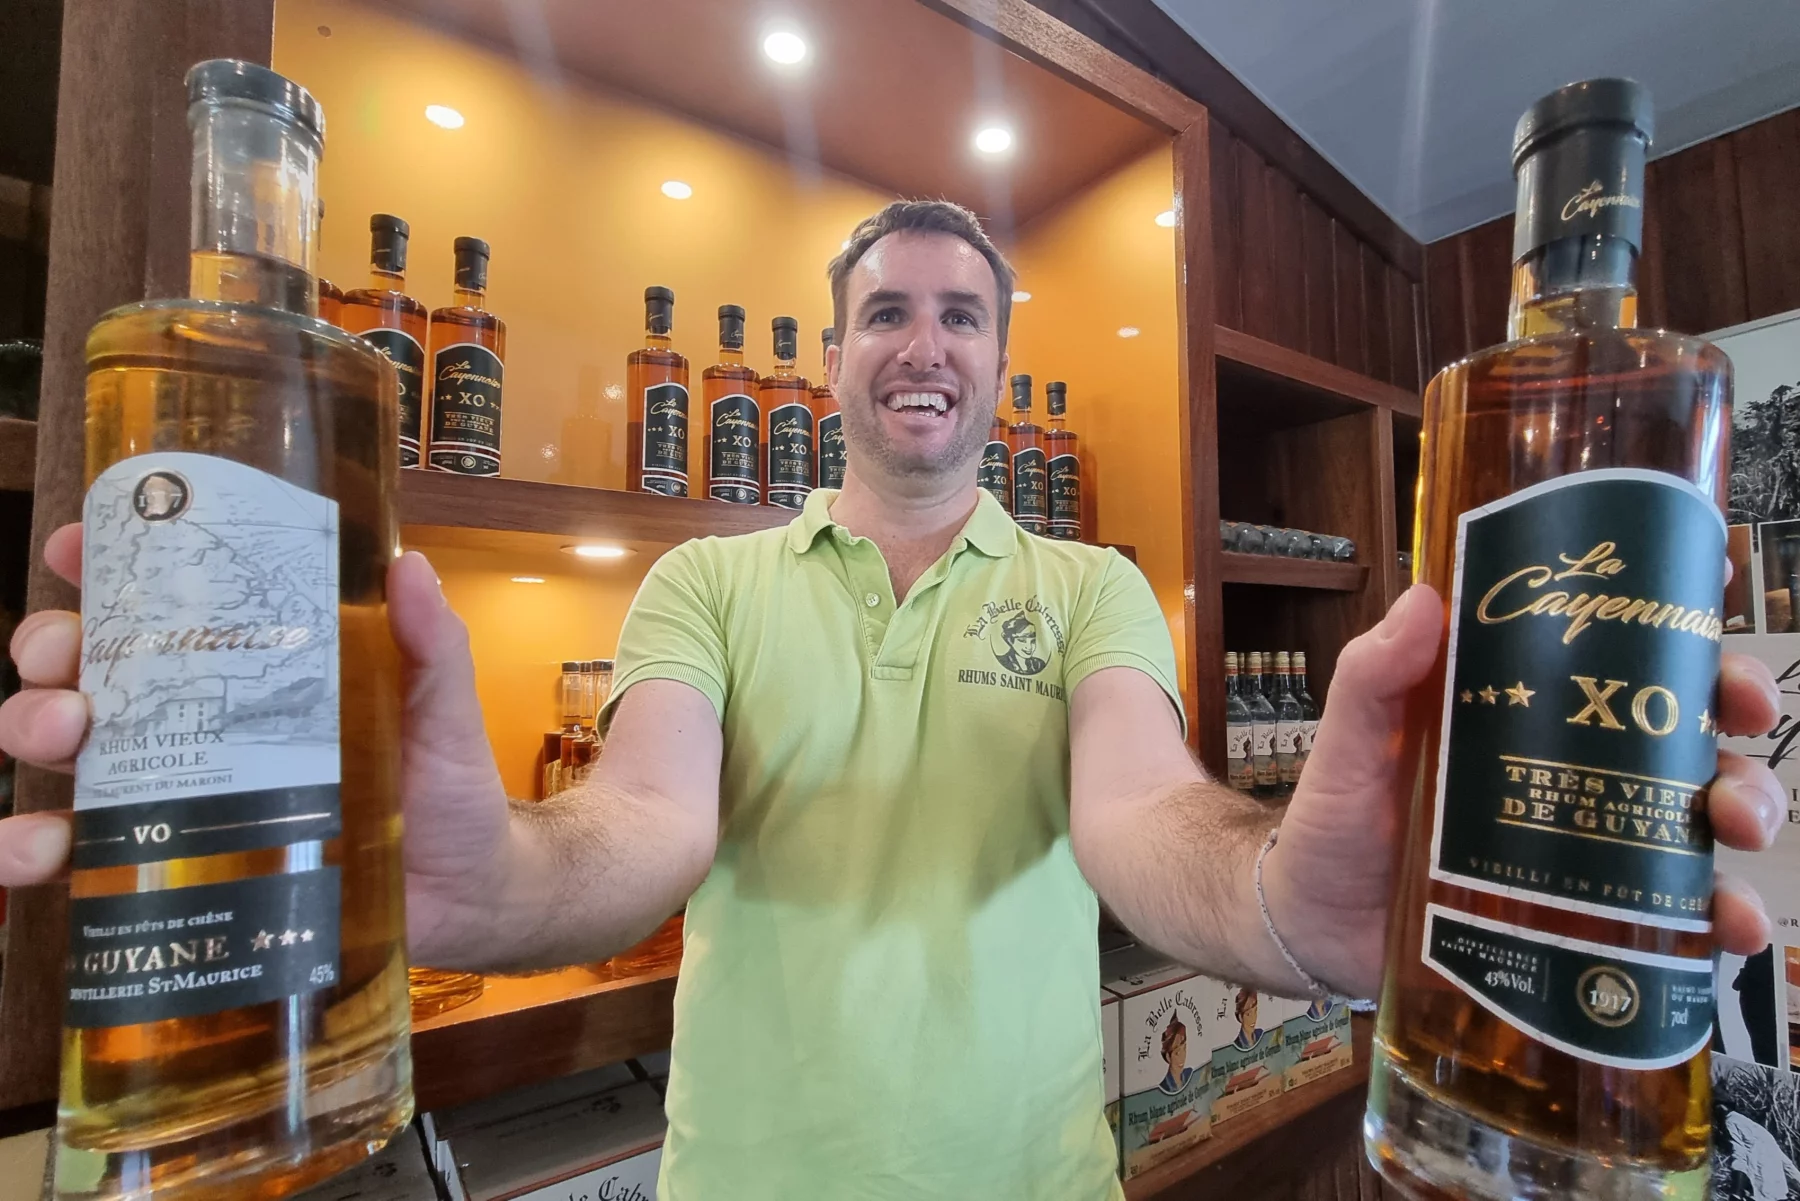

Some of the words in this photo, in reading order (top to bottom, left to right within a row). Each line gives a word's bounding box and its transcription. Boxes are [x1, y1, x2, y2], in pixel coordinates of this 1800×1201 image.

[455, 360, 471, 370] La
[458, 392, 486, 407] XO
[668, 425, 685, 439] XO
[732, 435, 751, 448] XO
[790, 443, 807, 455] XO
[993, 475, 1007, 485] XO
[1030, 481, 1044, 491] XO
[1063, 487, 1076, 496] XO
[1553, 541, 1627, 581] La
[1476, 565, 1723, 645] Cayennais
[963, 616, 988, 641] La
[982, 598, 1022, 625] Belle
[958, 669, 997, 686] RHUMS
[1000, 673, 1032, 692] SAINT
[1566, 675, 1680, 737] XO
[99, 736, 148, 756] RHUM
[155, 729, 225, 748] VIEUX
[108, 751, 209, 776] AGRICOLE
[154, 780, 174, 791] DU
[176, 774, 234, 789] MARONI
[1528, 788, 1596, 808] RHUM
[1620, 781, 1693, 810] VIEU
[1503, 797, 1555, 822] DE
[1574, 809, 1691, 844] GUYAN
[133, 823, 171, 845] VO
[1563, 876, 1590, 892] EN
[1652, 893, 1672, 908] DE
[117, 923, 132, 936] EN
[167, 918, 186, 930] DE
[187, 911, 233, 927] CHÊNE
[83, 935, 230, 975] GUYANE
[1441, 940, 1472, 956] SAINT
[1479, 952, 1538, 973] MAURICE
[1458, 937, 1538, 965] DISTILLERIE
[309, 963, 335, 983] 45%
[1216, 998, 1228, 1021] La
[1589, 989, 1632, 1013] 1917
[1138, 1035, 1152, 1062] La
[1145, 996, 1173, 1033] Belle
[1175, 990, 1203, 1037] Cabresse
[1671, 1008, 1689, 1027] 70cl
[1128, 1110, 1148, 1126] Rhum
